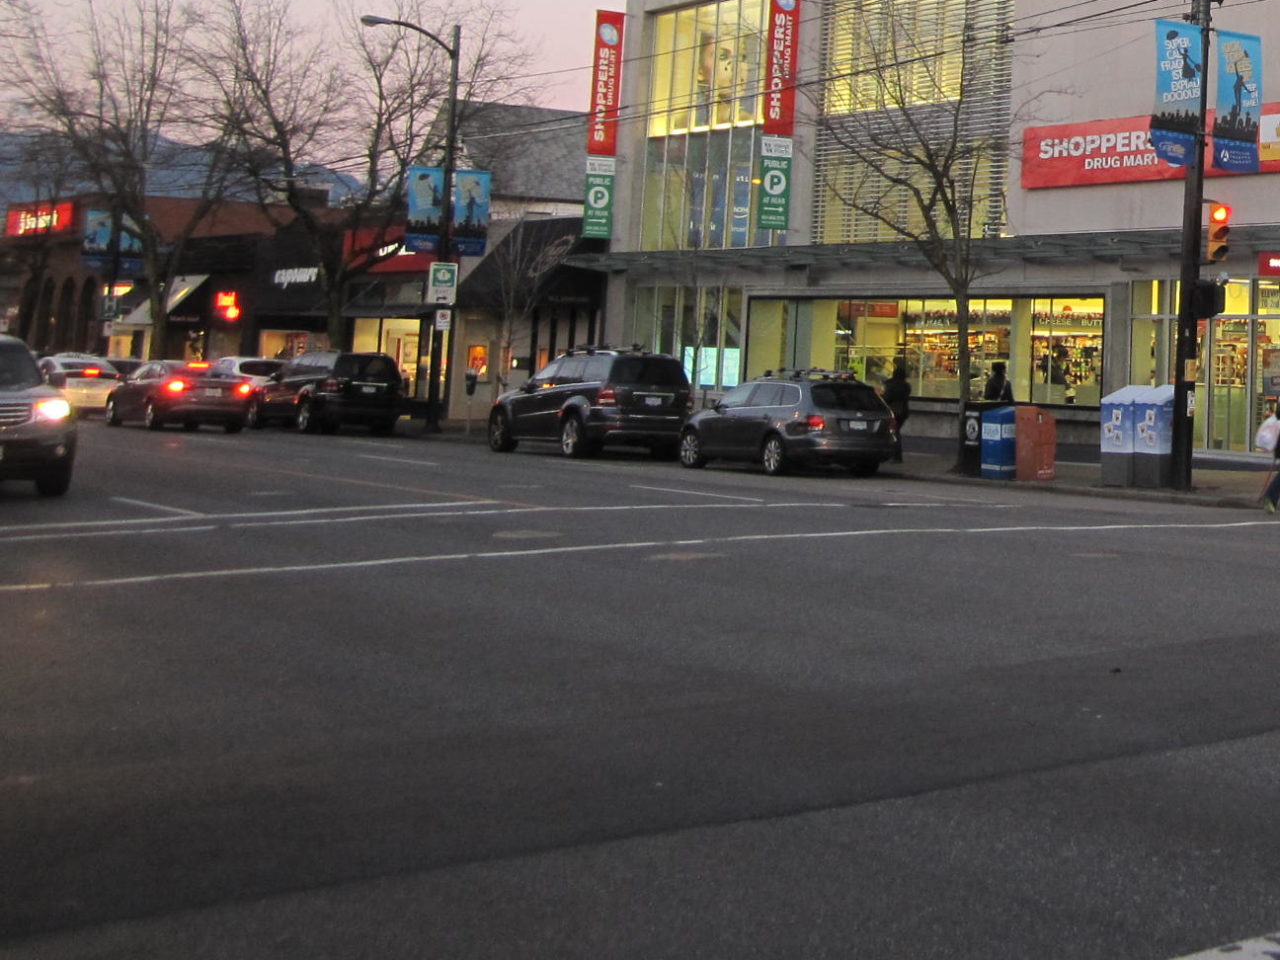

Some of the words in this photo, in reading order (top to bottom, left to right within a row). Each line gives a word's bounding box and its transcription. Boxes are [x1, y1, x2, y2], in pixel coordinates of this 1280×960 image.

[785, 14, 794, 46] MART
[769, 13, 786, 120] SHOPPERS
[594, 47, 611, 142] SHOPPERS
[606, 79, 615, 106] DRUG
[764, 159, 788, 168] PUBLIC
[1084, 156, 1120, 170] DRUG
[1123, 153, 1159, 167] MART
[1039, 318, 1072, 326] CHEESE
